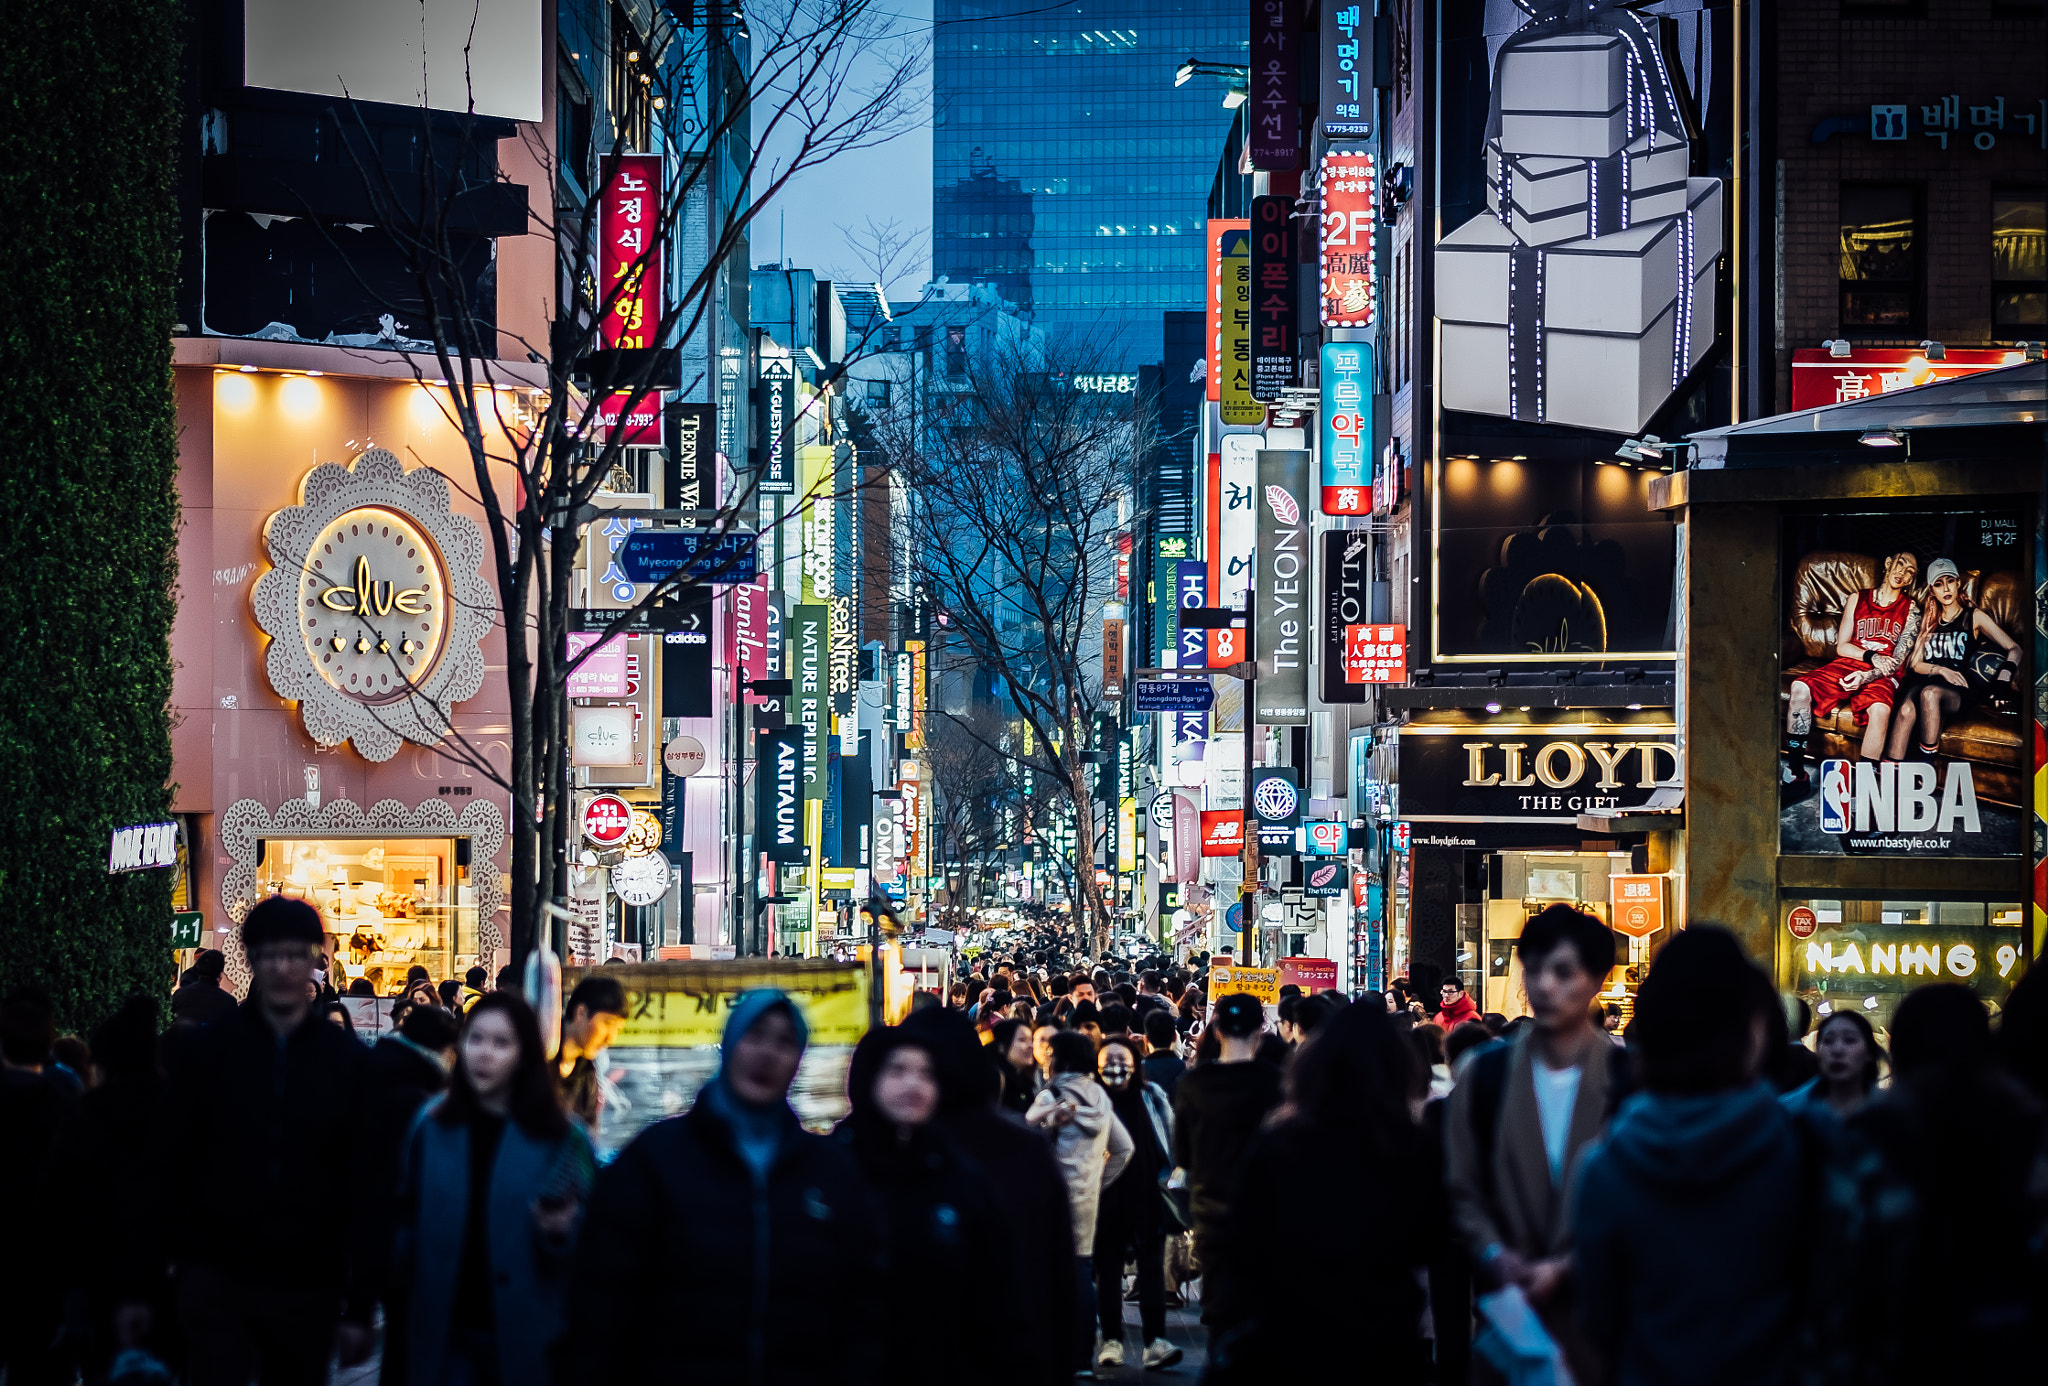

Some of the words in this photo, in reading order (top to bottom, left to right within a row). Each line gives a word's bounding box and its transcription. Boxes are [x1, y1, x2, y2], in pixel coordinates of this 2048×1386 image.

[1336, 5, 1360, 102] 백명기
[1335, 104, 1360, 118] 의원
[616, 172, 647, 254] 노정식
[1326, 211, 1370, 246] 2F
[770, 381, 782, 480] K-GUESTHOUSE
[1331, 353, 1365, 479] 푸른약국
[680, 415, 700, 480] TEENIE
[1994, 519, 2018, 528] MALL
[319, 554, 427, 617] clue
[1273, 528, 1299, 617] YEON
[664, 632, 708, 645] adidas
[736, 583, 765, 661] banila
[1857, 617, 1901, 644] BULLS
[802, 621, 818, 692] NATURE
[1273, 619, 1299, 675] The
[600, 673, 619, 683] Nail
[1138, 683, 1180, 694] 명동8가길
[1138, 695, 1181, 703] Myeongdong
[666, 751, 704, 761] 삼성부동산
[1462, 742, 1678, 789] LLOYD
[777, 741, 796, 844] ARITAUM
[1518, 795, 1562, 811] THE
[1567, 795, 1620, 810] GIFT
[1855, 761, 1982, 833] NBA
[1313, 824, 1343, 855] 약
[1824, 817, 1842, 829] NBA
[1411, 835, 1476, 847] www.lloydgift.com
[1850, 836, 1951, 850] www.nbastyle.co.kr
[1794, 917, 1812, 925] TAX
[1805, 941, 1977, 977] NANING
